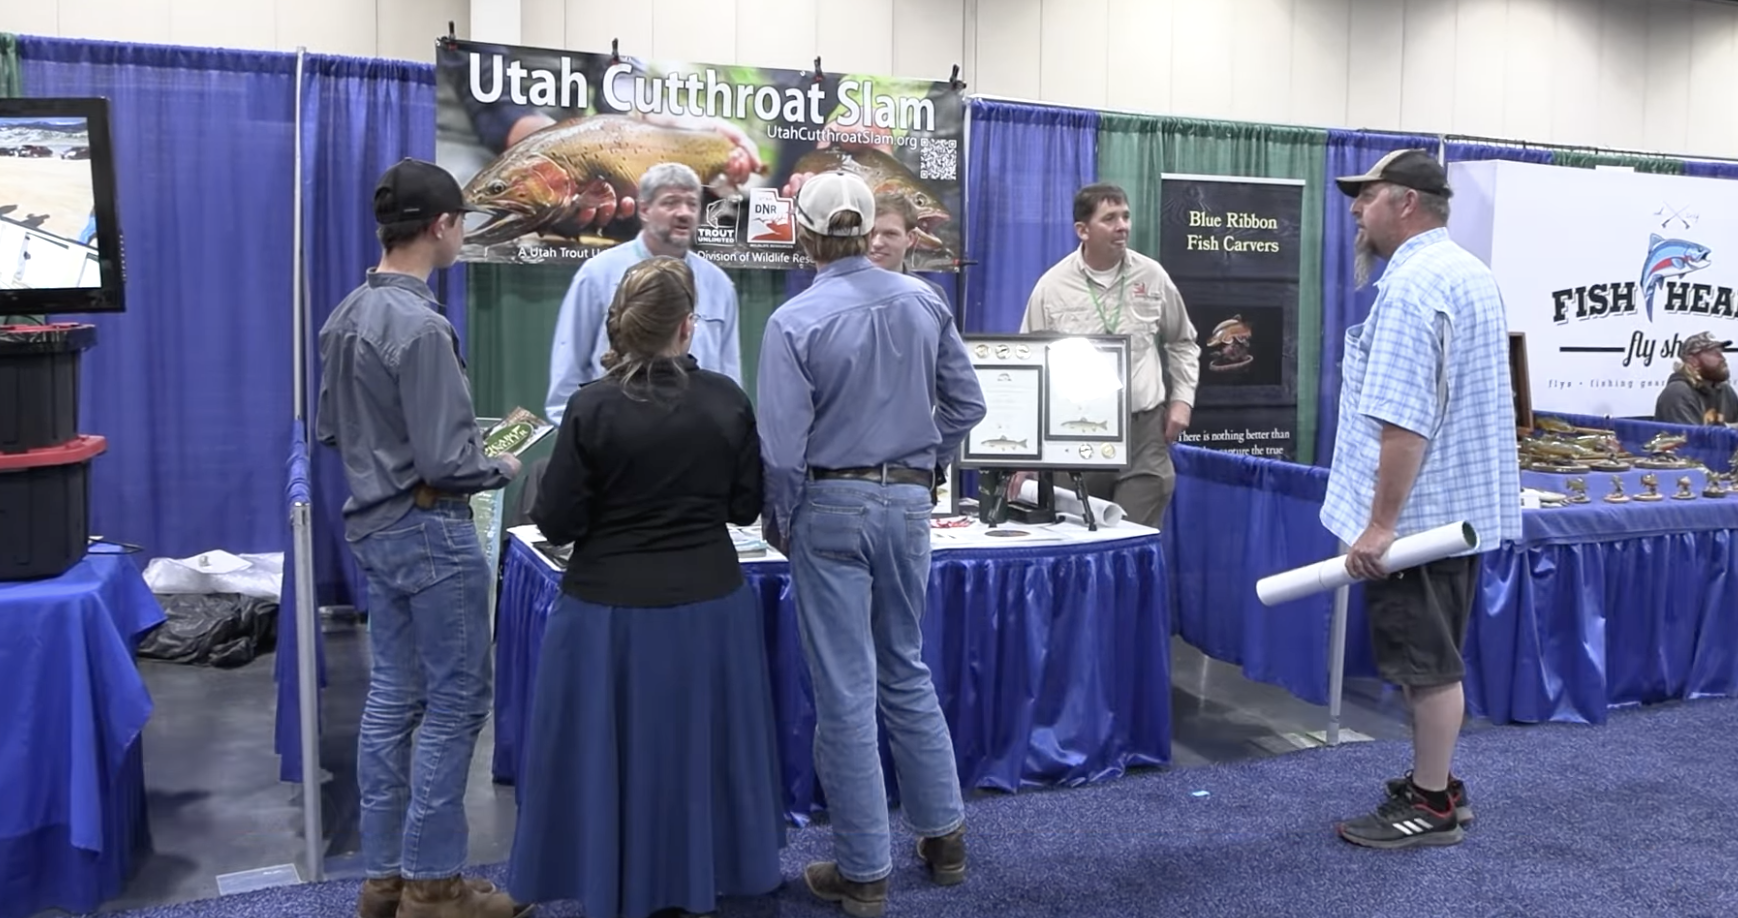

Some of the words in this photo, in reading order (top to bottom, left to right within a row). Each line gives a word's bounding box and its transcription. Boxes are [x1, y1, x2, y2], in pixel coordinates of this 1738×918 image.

[469, 52, 588, 109] Utah
[602, 62, 826, 125] Cutthroat
[836, 80, 936, 132] Slam
[766, 124, 918, 149] UtahCutthroatSlam.org
[755, 203, 777, 215] DNR
[1189, 210, 1222, 228] Blue
[1226, 212, 1278, 229] Ribbon
[697, 228, 735, 238] TROUT
[697, 236, 735, 244] UNLIMITED
[1186, 234, 1219, 251] Fish
[1223, 235, 1280, 253] Carvers
[518, 247, 527, 257] A
[530, 247, 557, 258] Utah
[559, 247, 589, 259] Trout
[696, 250, 737, 262] Division
[739, 251, 750, 262] of
[752, 252, 790, 263] Wildlife
[1552, 281, 1637, 324] FISH
[1664, 281, 1738, 319] HEA
[1622, 329, 1657, 367] fly
[1660, 332, 1682, 359] sh
[1590, 379, 1633, 389] fishing
[1203, 430, 1210, 441] is
[1211, 428, 1245, 443] nothing
[1245, 428, 1270, 440] better
[1271, 427, 1290, 439] than
[1251, 444, 1265, 455] the
[1265, 446, 1284, 455] true
